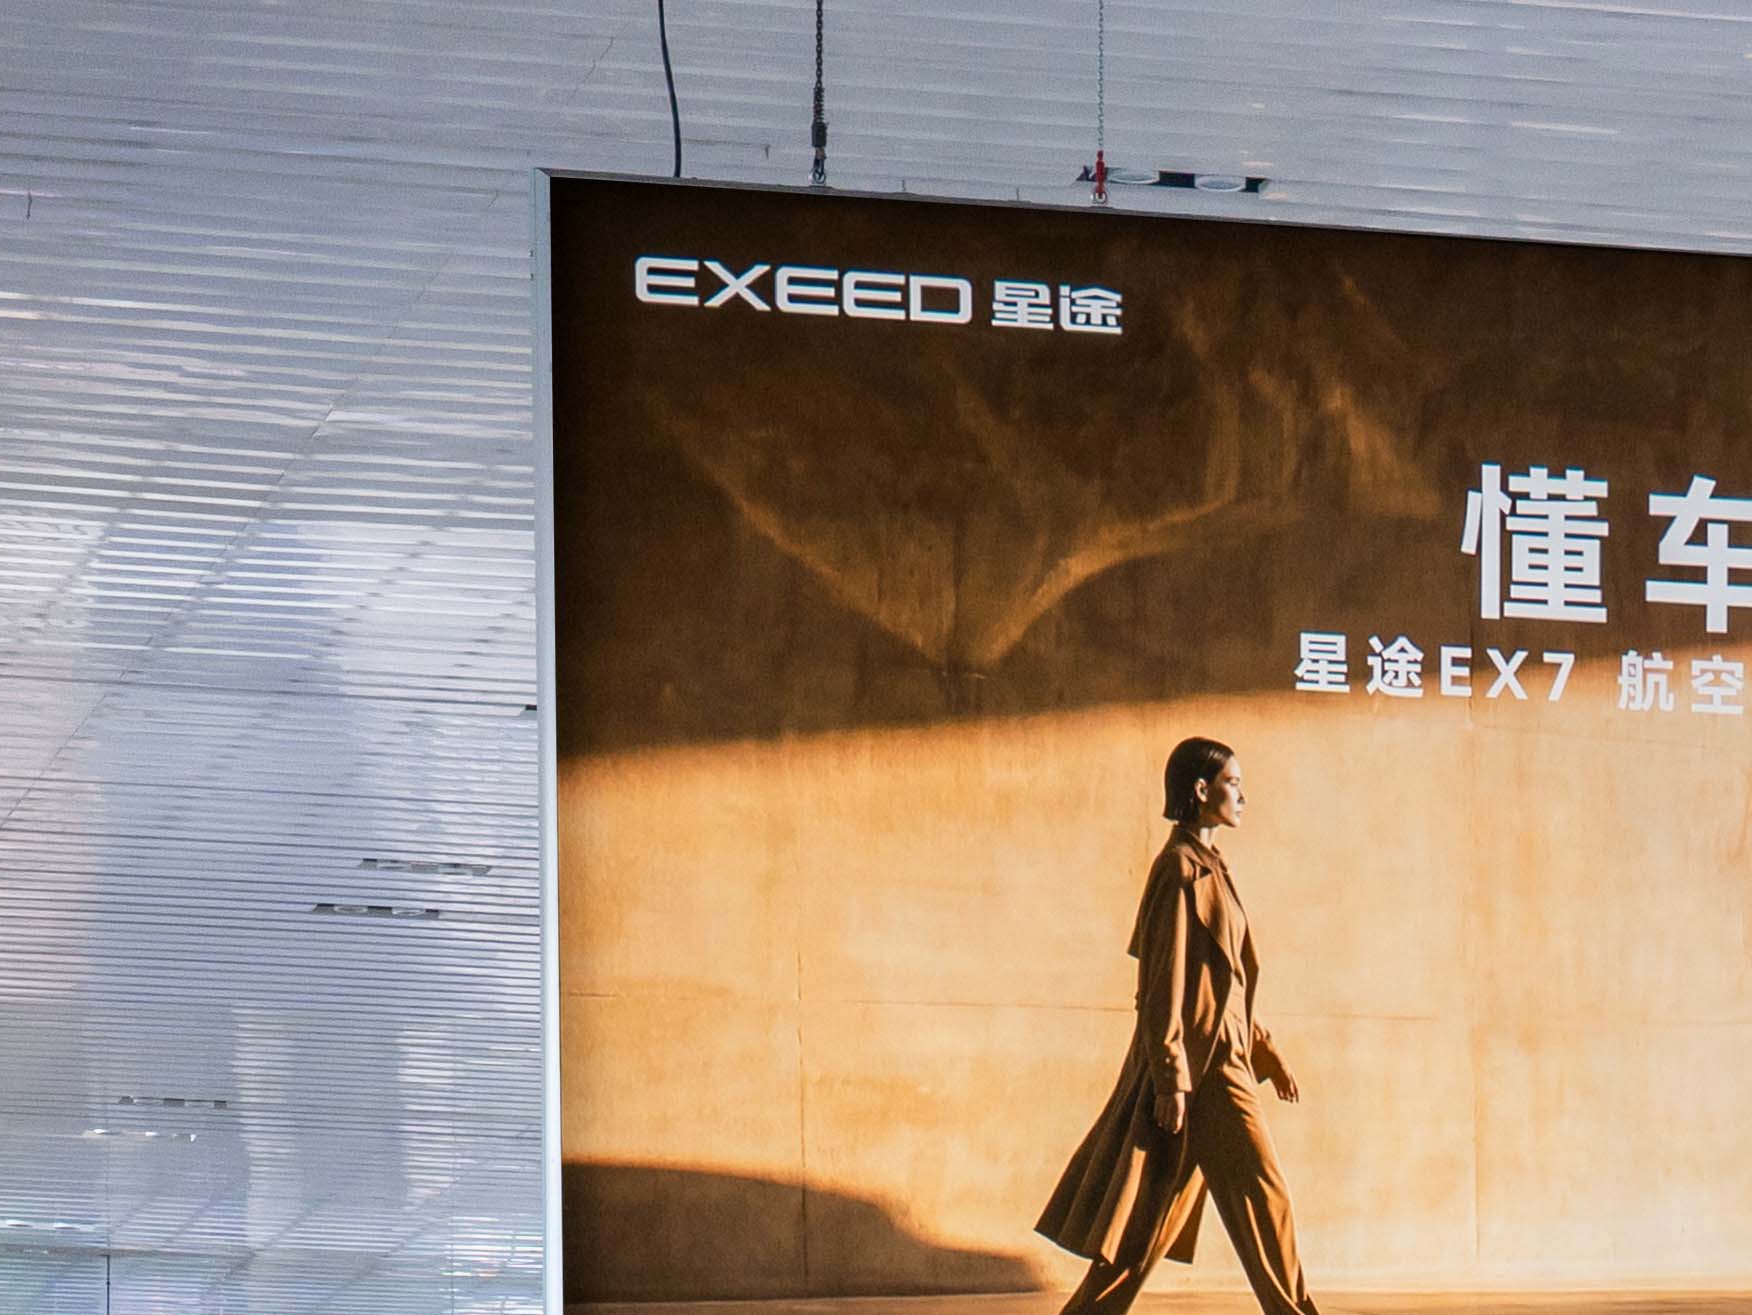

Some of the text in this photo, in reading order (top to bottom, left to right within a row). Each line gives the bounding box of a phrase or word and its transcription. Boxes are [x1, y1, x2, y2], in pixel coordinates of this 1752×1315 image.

[634, 255, 1124, 334] EXEED 星途
[1294, 630, 1574, 703] 星途EX7
